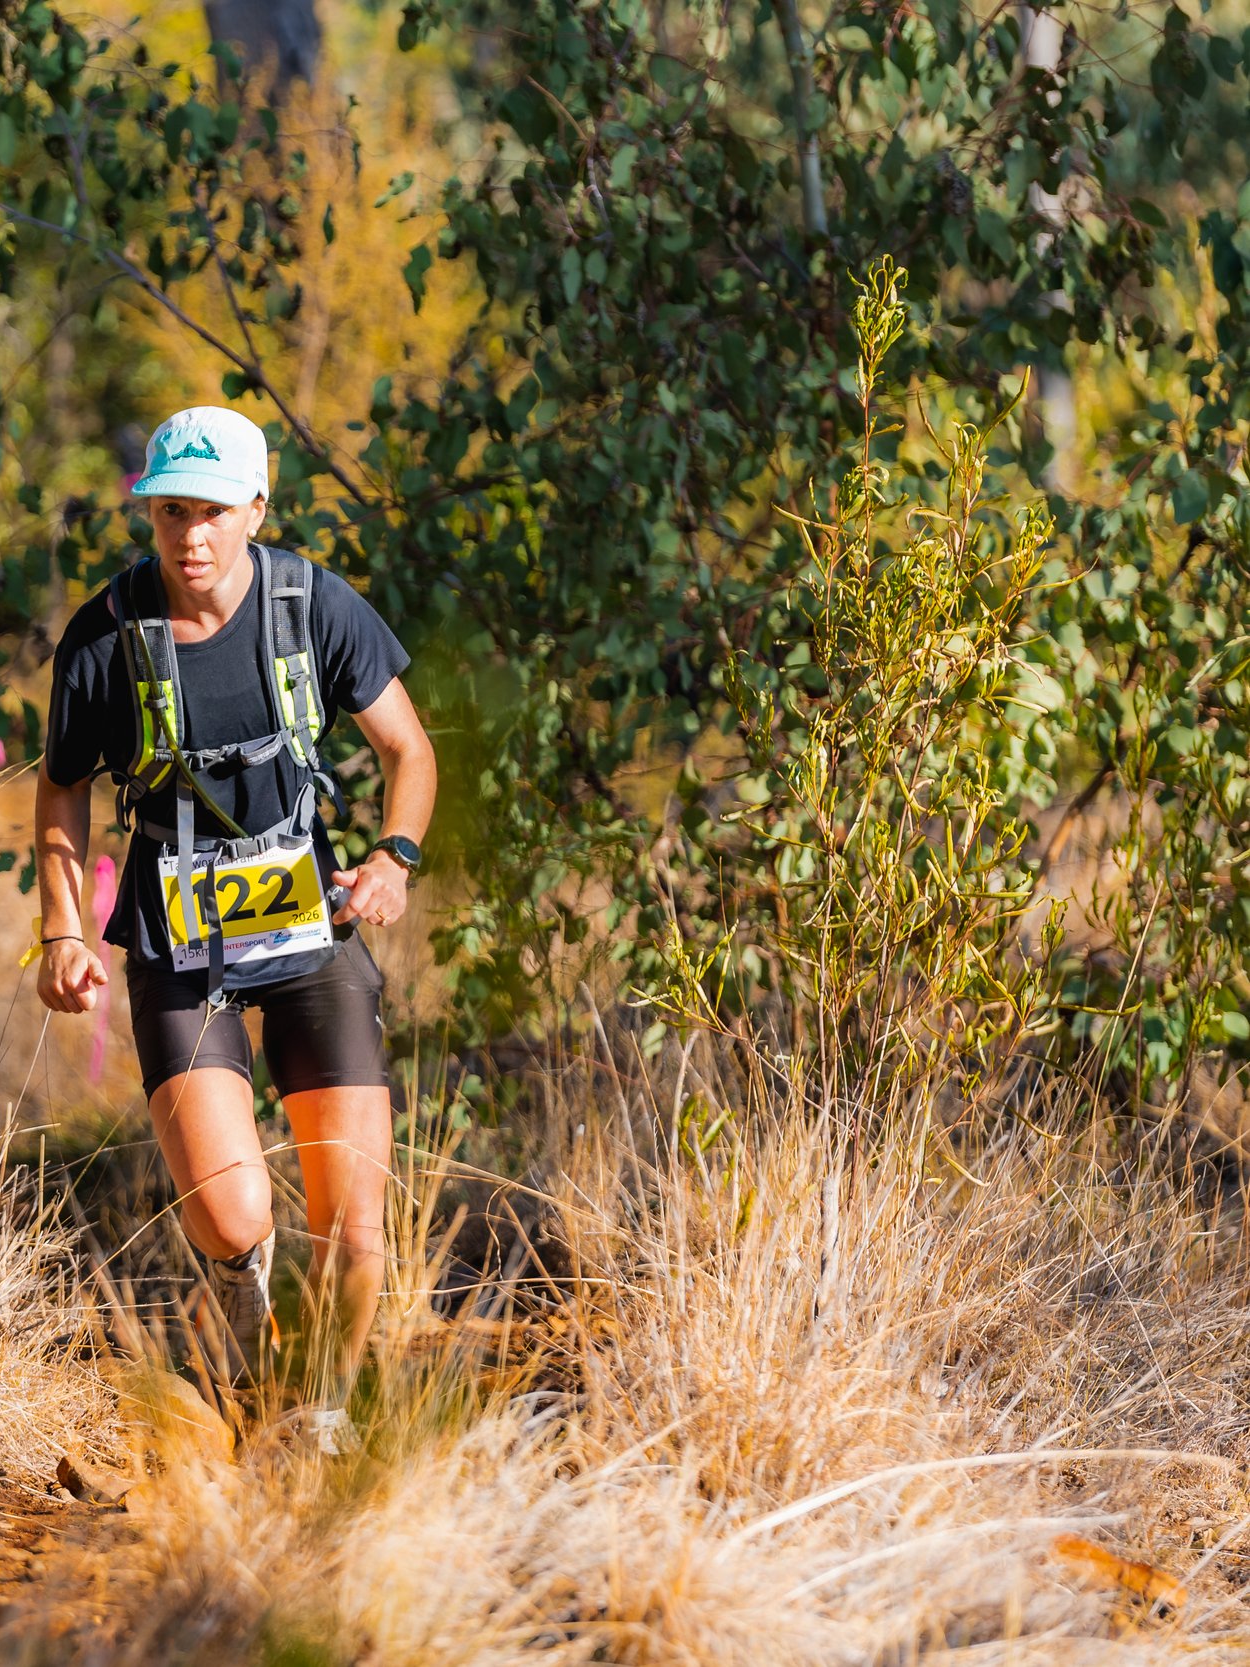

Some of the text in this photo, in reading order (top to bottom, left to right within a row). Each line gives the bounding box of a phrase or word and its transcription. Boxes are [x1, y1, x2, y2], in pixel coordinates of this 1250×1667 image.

[192, 866, 300, 925] 122
[292, 909, 320, 923] 2026
[223, 938, 268, 951] INTERSPORT
